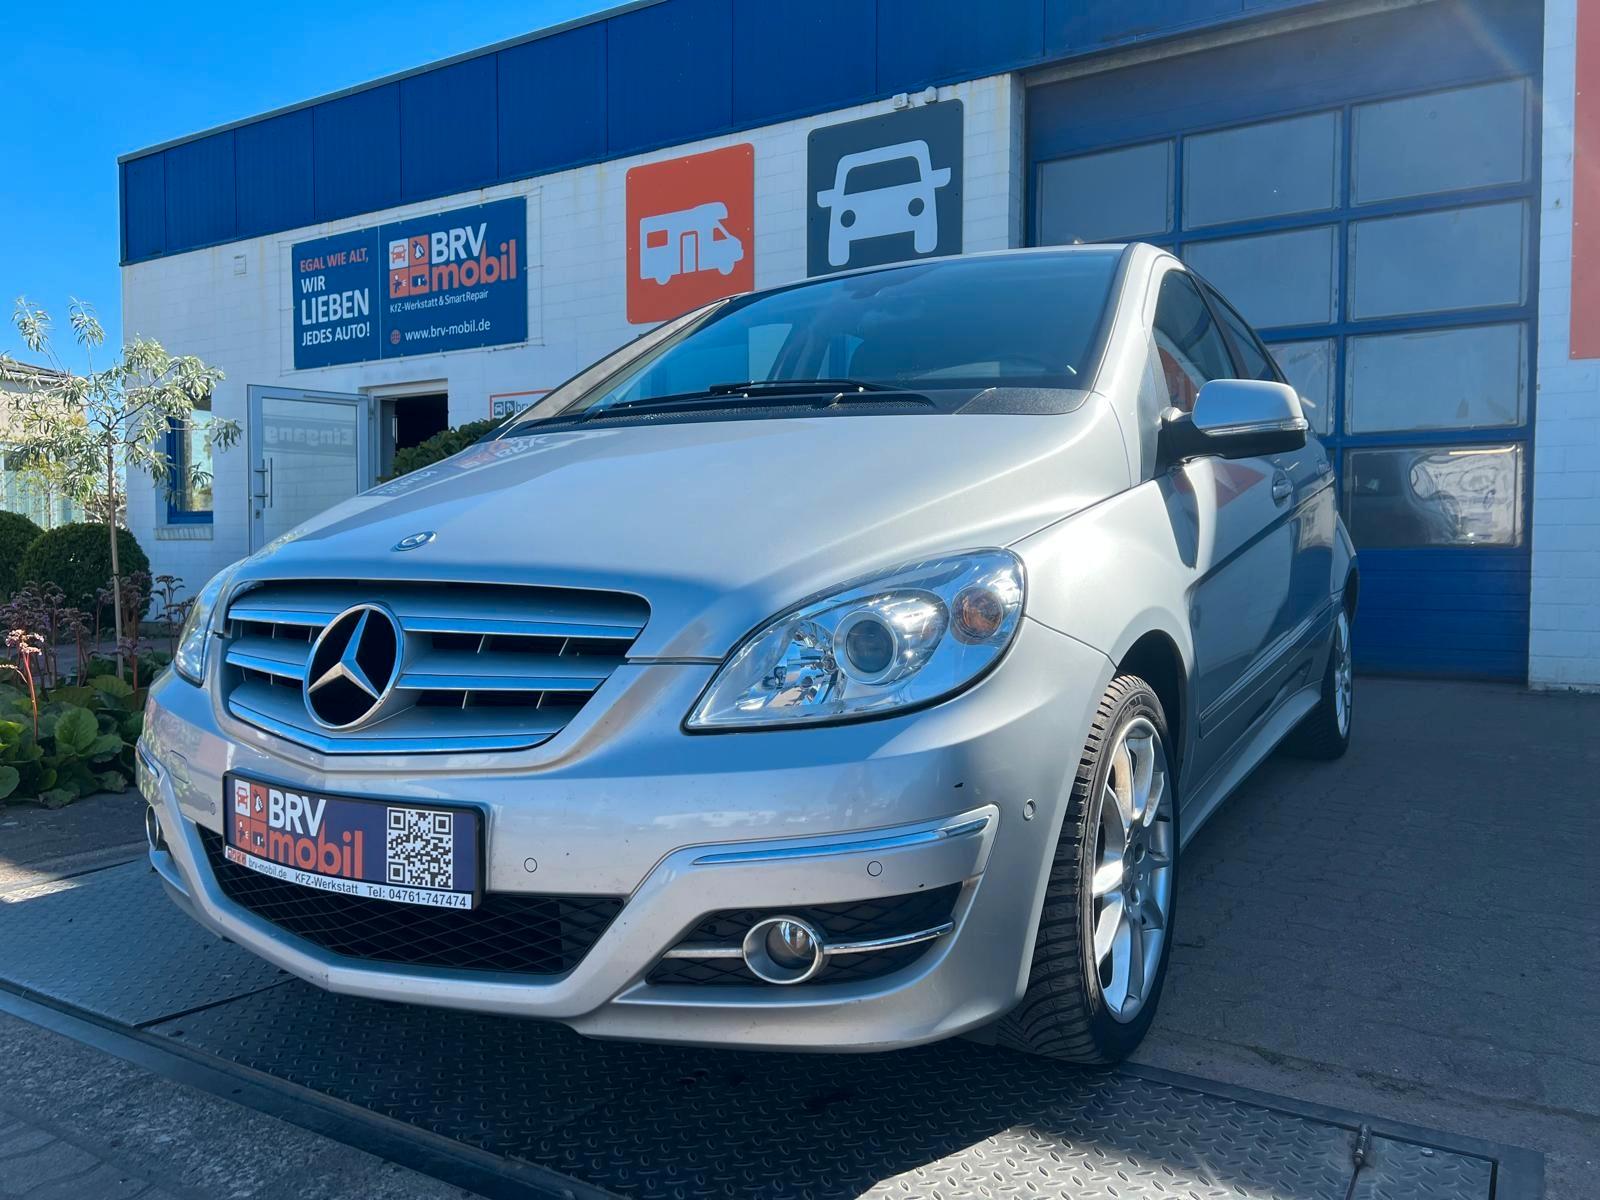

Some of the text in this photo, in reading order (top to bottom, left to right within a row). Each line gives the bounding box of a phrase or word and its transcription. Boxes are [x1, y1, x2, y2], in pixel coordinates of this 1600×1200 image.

[300, 247, 369, 273] EGAL WIE ALT,
[431, 222, 488, 265] BRV
[301, 275, 326, 294] WIR
[431, 239, 517, 292] mobil
[301, 287, 369, 326] LIEBEN
[438, 295, 444, 306] &
[302, 321, 370, 346] JEDES AUTO!
[404, 318, 491, 341] www.brv-mobil.de
[268, 788, 327, 837] BRV
[268, 819, 363, 880] mobil
[248, 857, 467, 907] brv-mobil.de KFZ-Werkstatt Tel: 04761-747474
